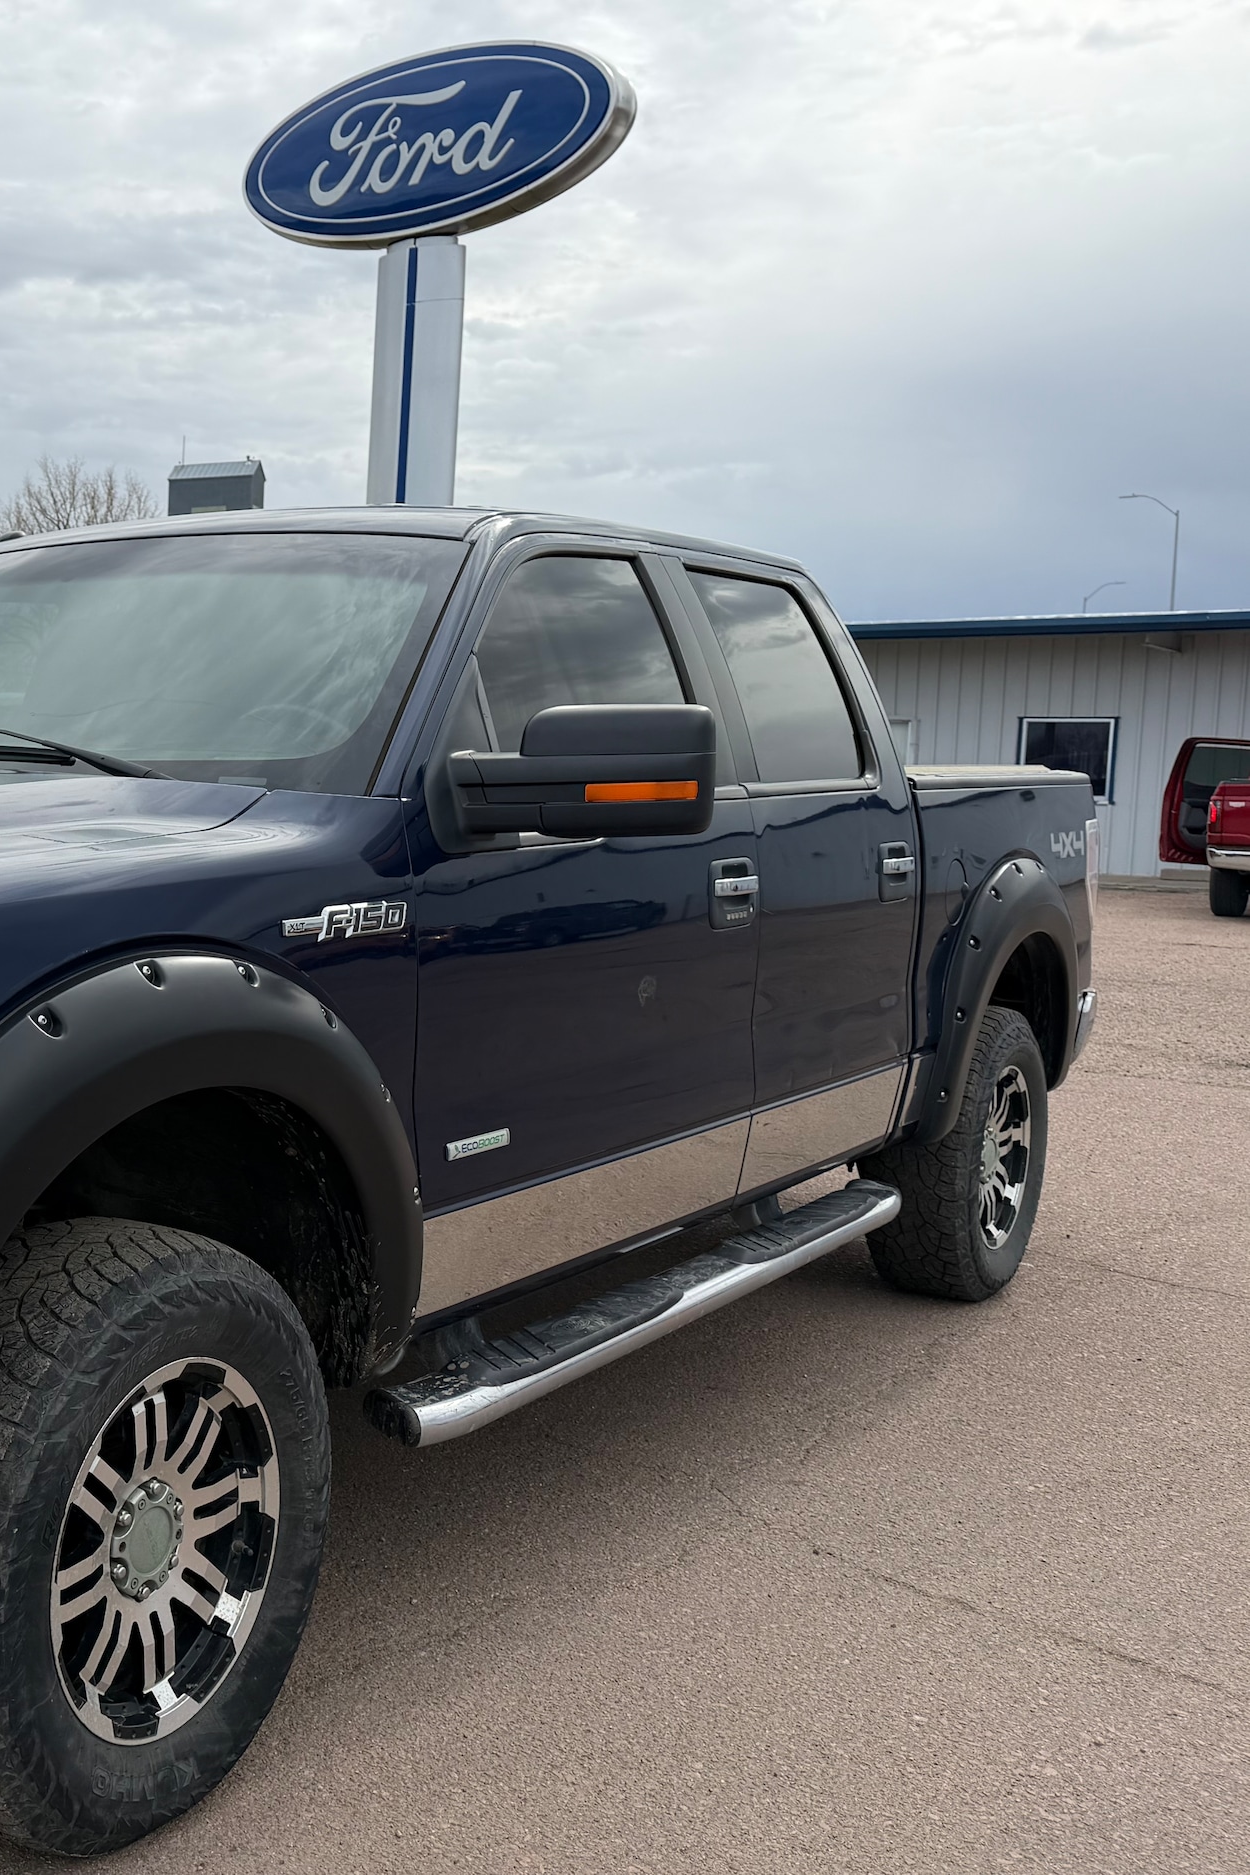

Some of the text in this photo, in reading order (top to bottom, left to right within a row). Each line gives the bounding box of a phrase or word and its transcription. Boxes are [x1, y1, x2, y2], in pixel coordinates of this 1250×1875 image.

[309, 79, 523, 207] Ford
[1050, 830, 1084, 859] 4X4
[289, 922, 306, 932] XLT
[461, 1134, 506, 1153] ECOBOOST
